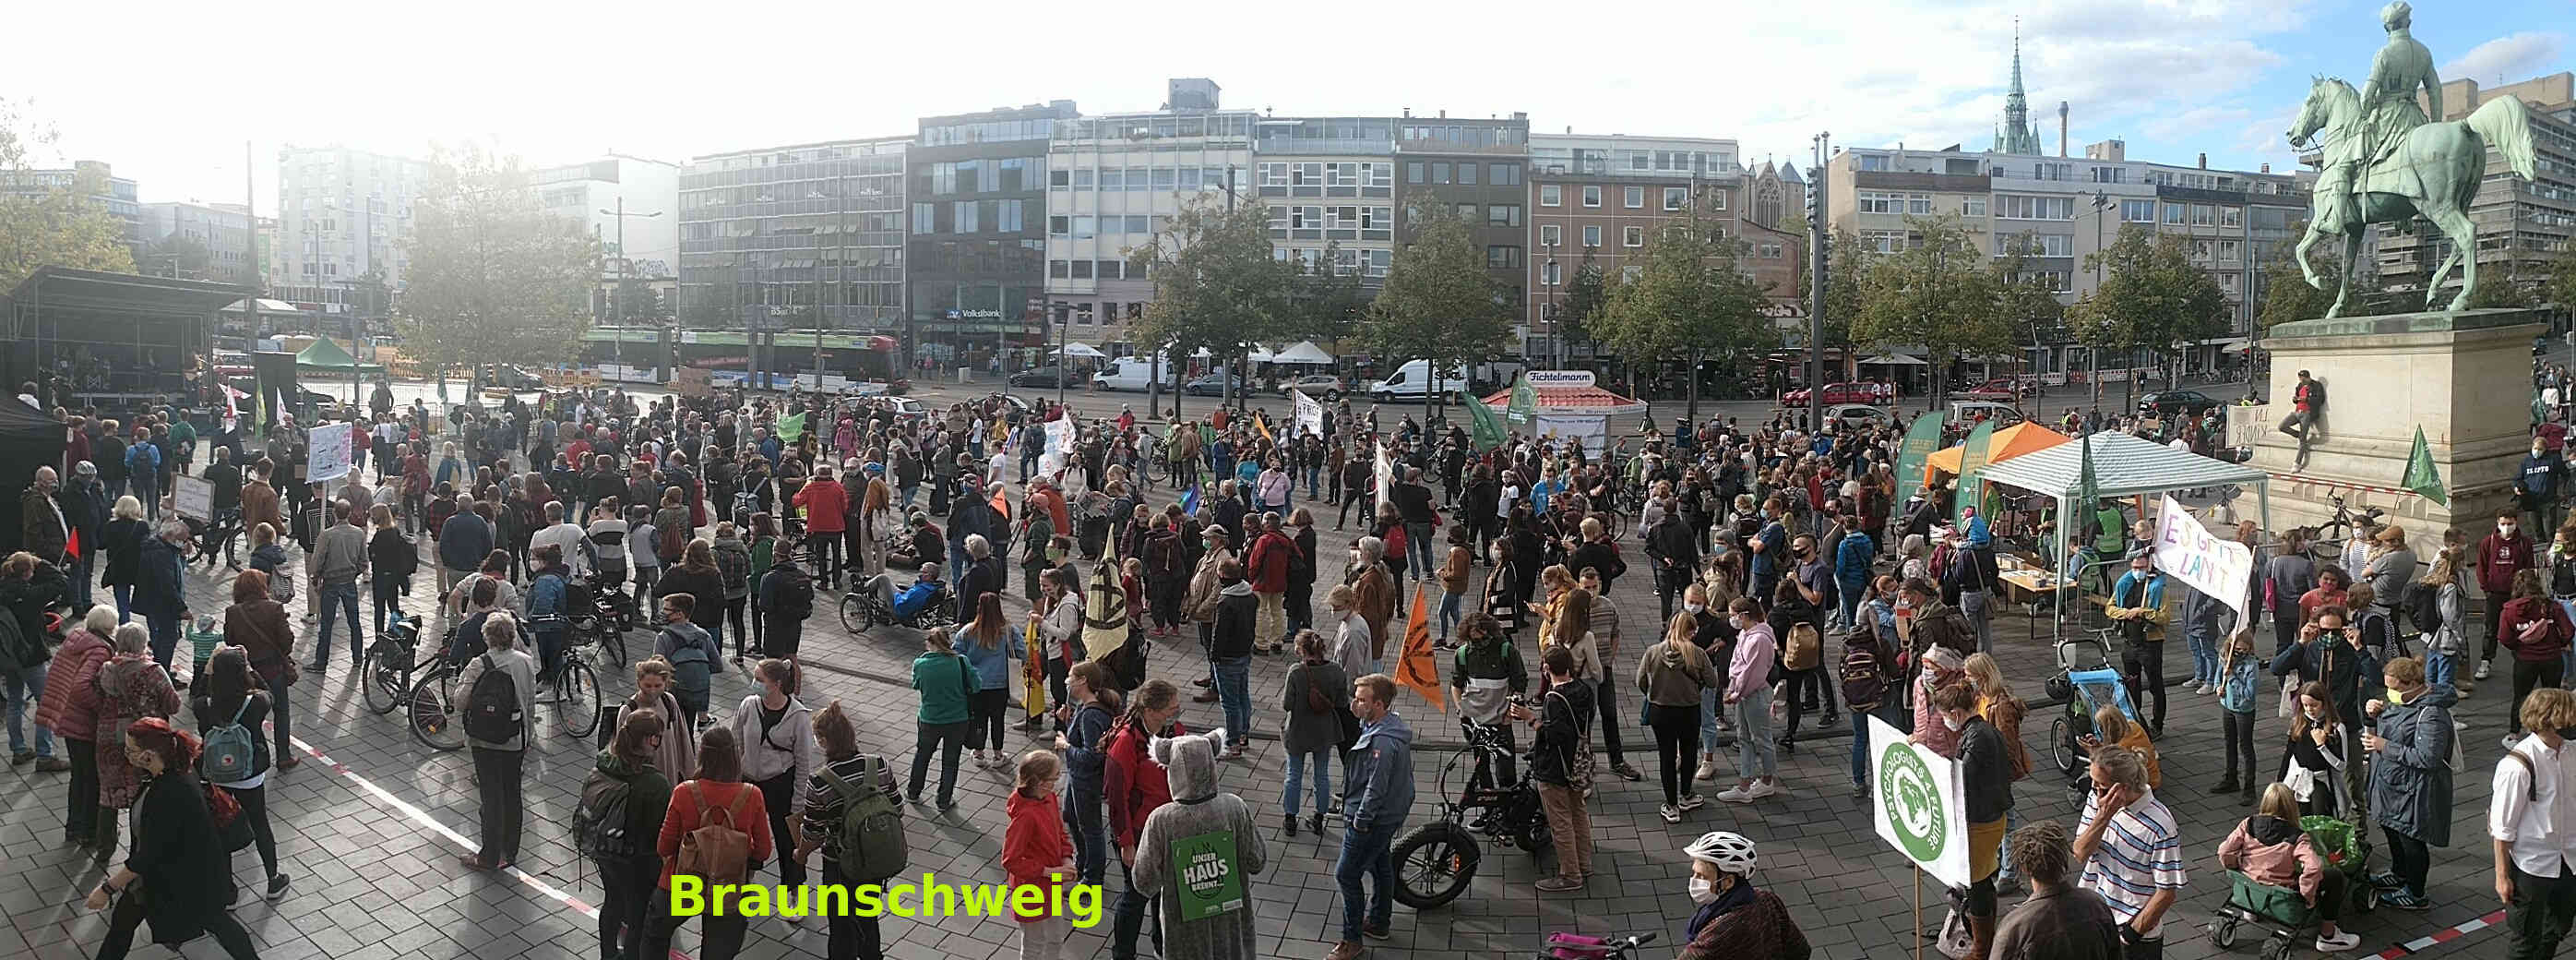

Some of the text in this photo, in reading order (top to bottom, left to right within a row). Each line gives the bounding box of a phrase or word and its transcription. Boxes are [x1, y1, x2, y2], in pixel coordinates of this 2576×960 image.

[962, 309, 1002, 318] Volksbank
[1927, 795, 1942, 851] FUTURE
[1192, 853, 1217, 864] UNSER
[1183, 858, 1229, 885] HAUS
